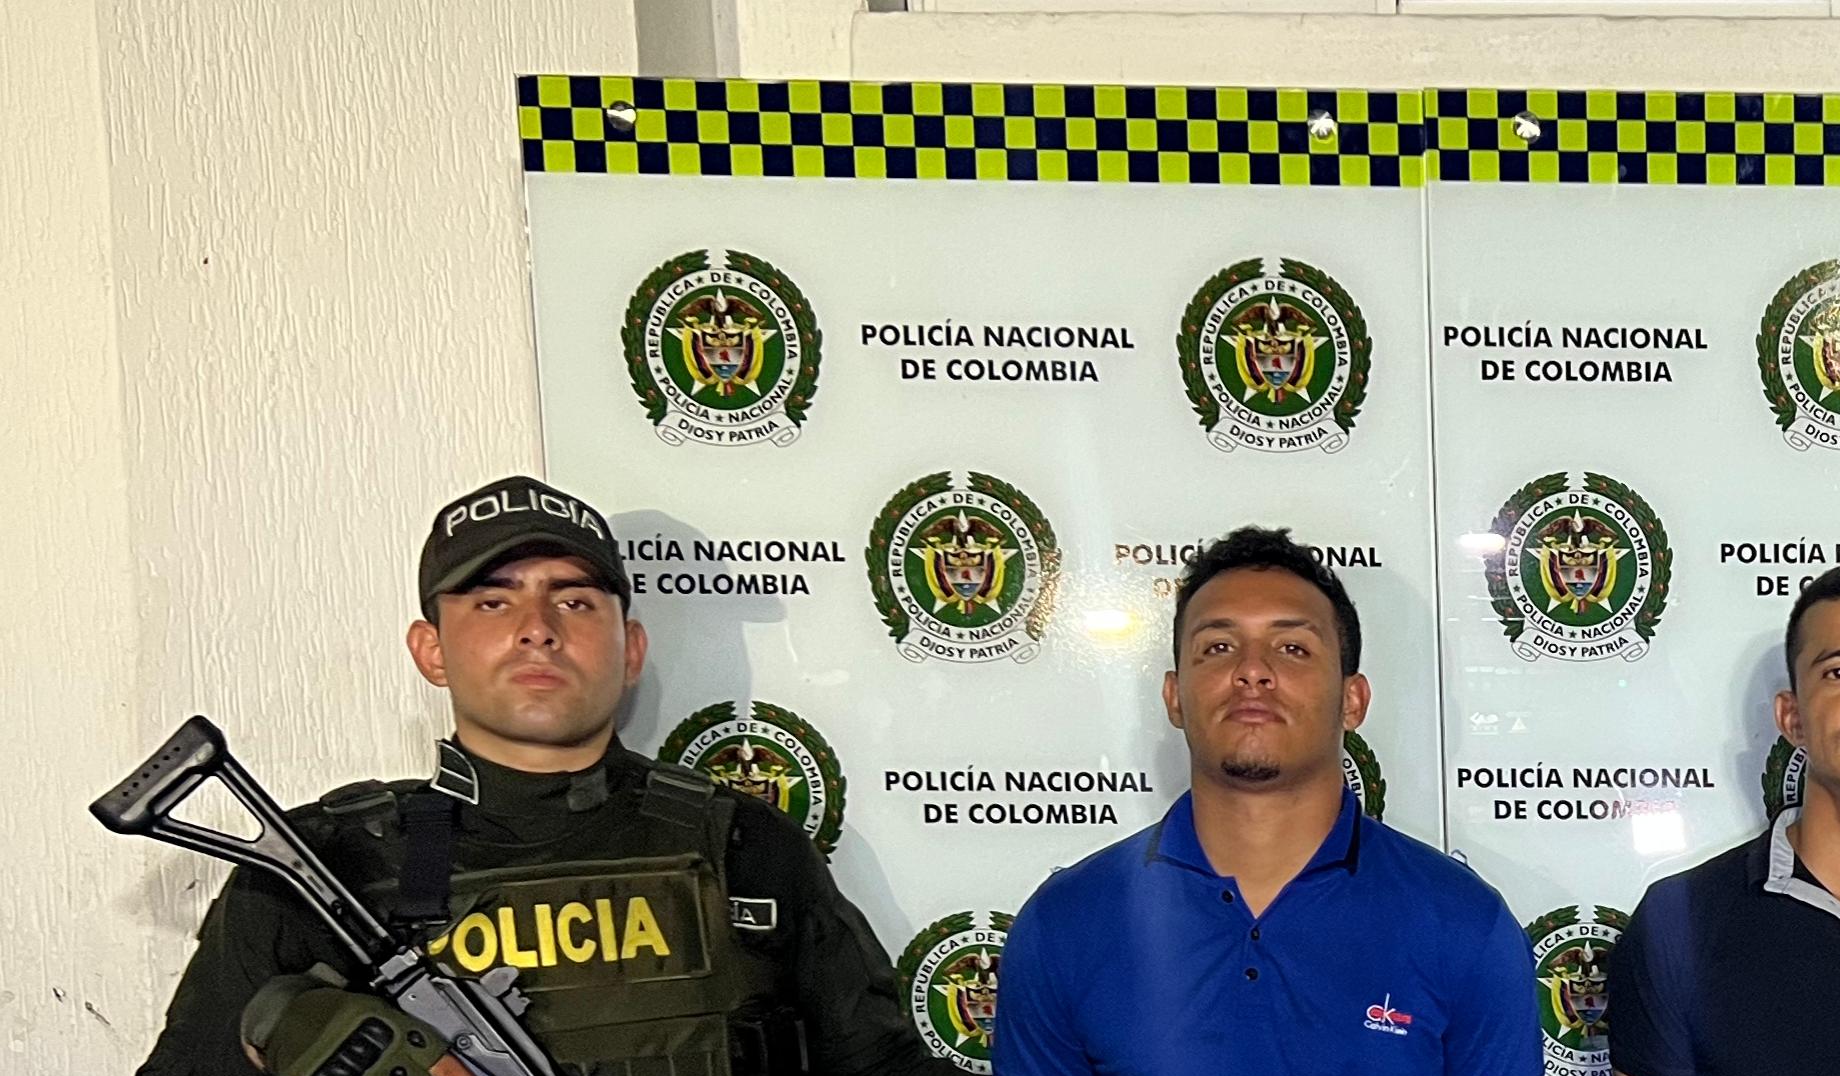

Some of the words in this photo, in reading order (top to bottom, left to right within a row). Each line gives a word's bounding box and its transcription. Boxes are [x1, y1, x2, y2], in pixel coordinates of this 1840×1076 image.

[711, 272, 731, 283] DE
[749, 282, 798, 359] COLOMBIA
[1265, 280, 1284, 291] DE
[1302, 290, 1348, 366] COLOMBIA
[862, 319, 974, 346] POLICÍA
[984, 326, 1134, 348] NACIONAL
[1444, 320, 1552, 347] POLICÍA
[1563, 328, 1707, 349] NACIONAL
[902, 359, 936, 379] DE
[947, 359, 1098, 381] COLOMBIA
[1482, 360, 1514, 380] DE
[1526, 361, 1672, 382] COLOMBIA
[729, 378, 793, 423] NACIONAL
[1279, 385, 1342, 430] NACIONAL
[729, 420, 780, 442] PATRIA
[1279, 427, 1329, 448] PATRIA
[953, 493, 973, 504] DE
[1569, 494, 1588, 504] DE
[1604, 503, 1649, 577] COLOMBIA
[694, 541, 845, 561] NACIONAL
[1720, 537, 1825, 564] POLICÍA
[657, 573, 809, 594] COLOMBIA
[1757, 575, 1789, 596] DE
[1582, 595, 1643, 639] NACIONAL
[970, 637, 1019, 658] PATRIA
[1581, 636, 1629, 657] PATRIA
[737, 722, 757, 733] DE
[774, 731, 822, 805] COLOMBIA
[886, 765, 995, 791] POLICÍA
[1006, 772, 1153, 792] NACIONAL
[1458, 762, 1563, 788] POLICÍA
[1573, 768, 1714, 788] NACIONAL
[924, 804, 958, 823] DE
[969, 804, 1117, 824] COLOMBIA
[1495, 800, 1527, 819] DE
[975, 932, 994, 942] DE
[1580, 926, 1598, 936] DE
